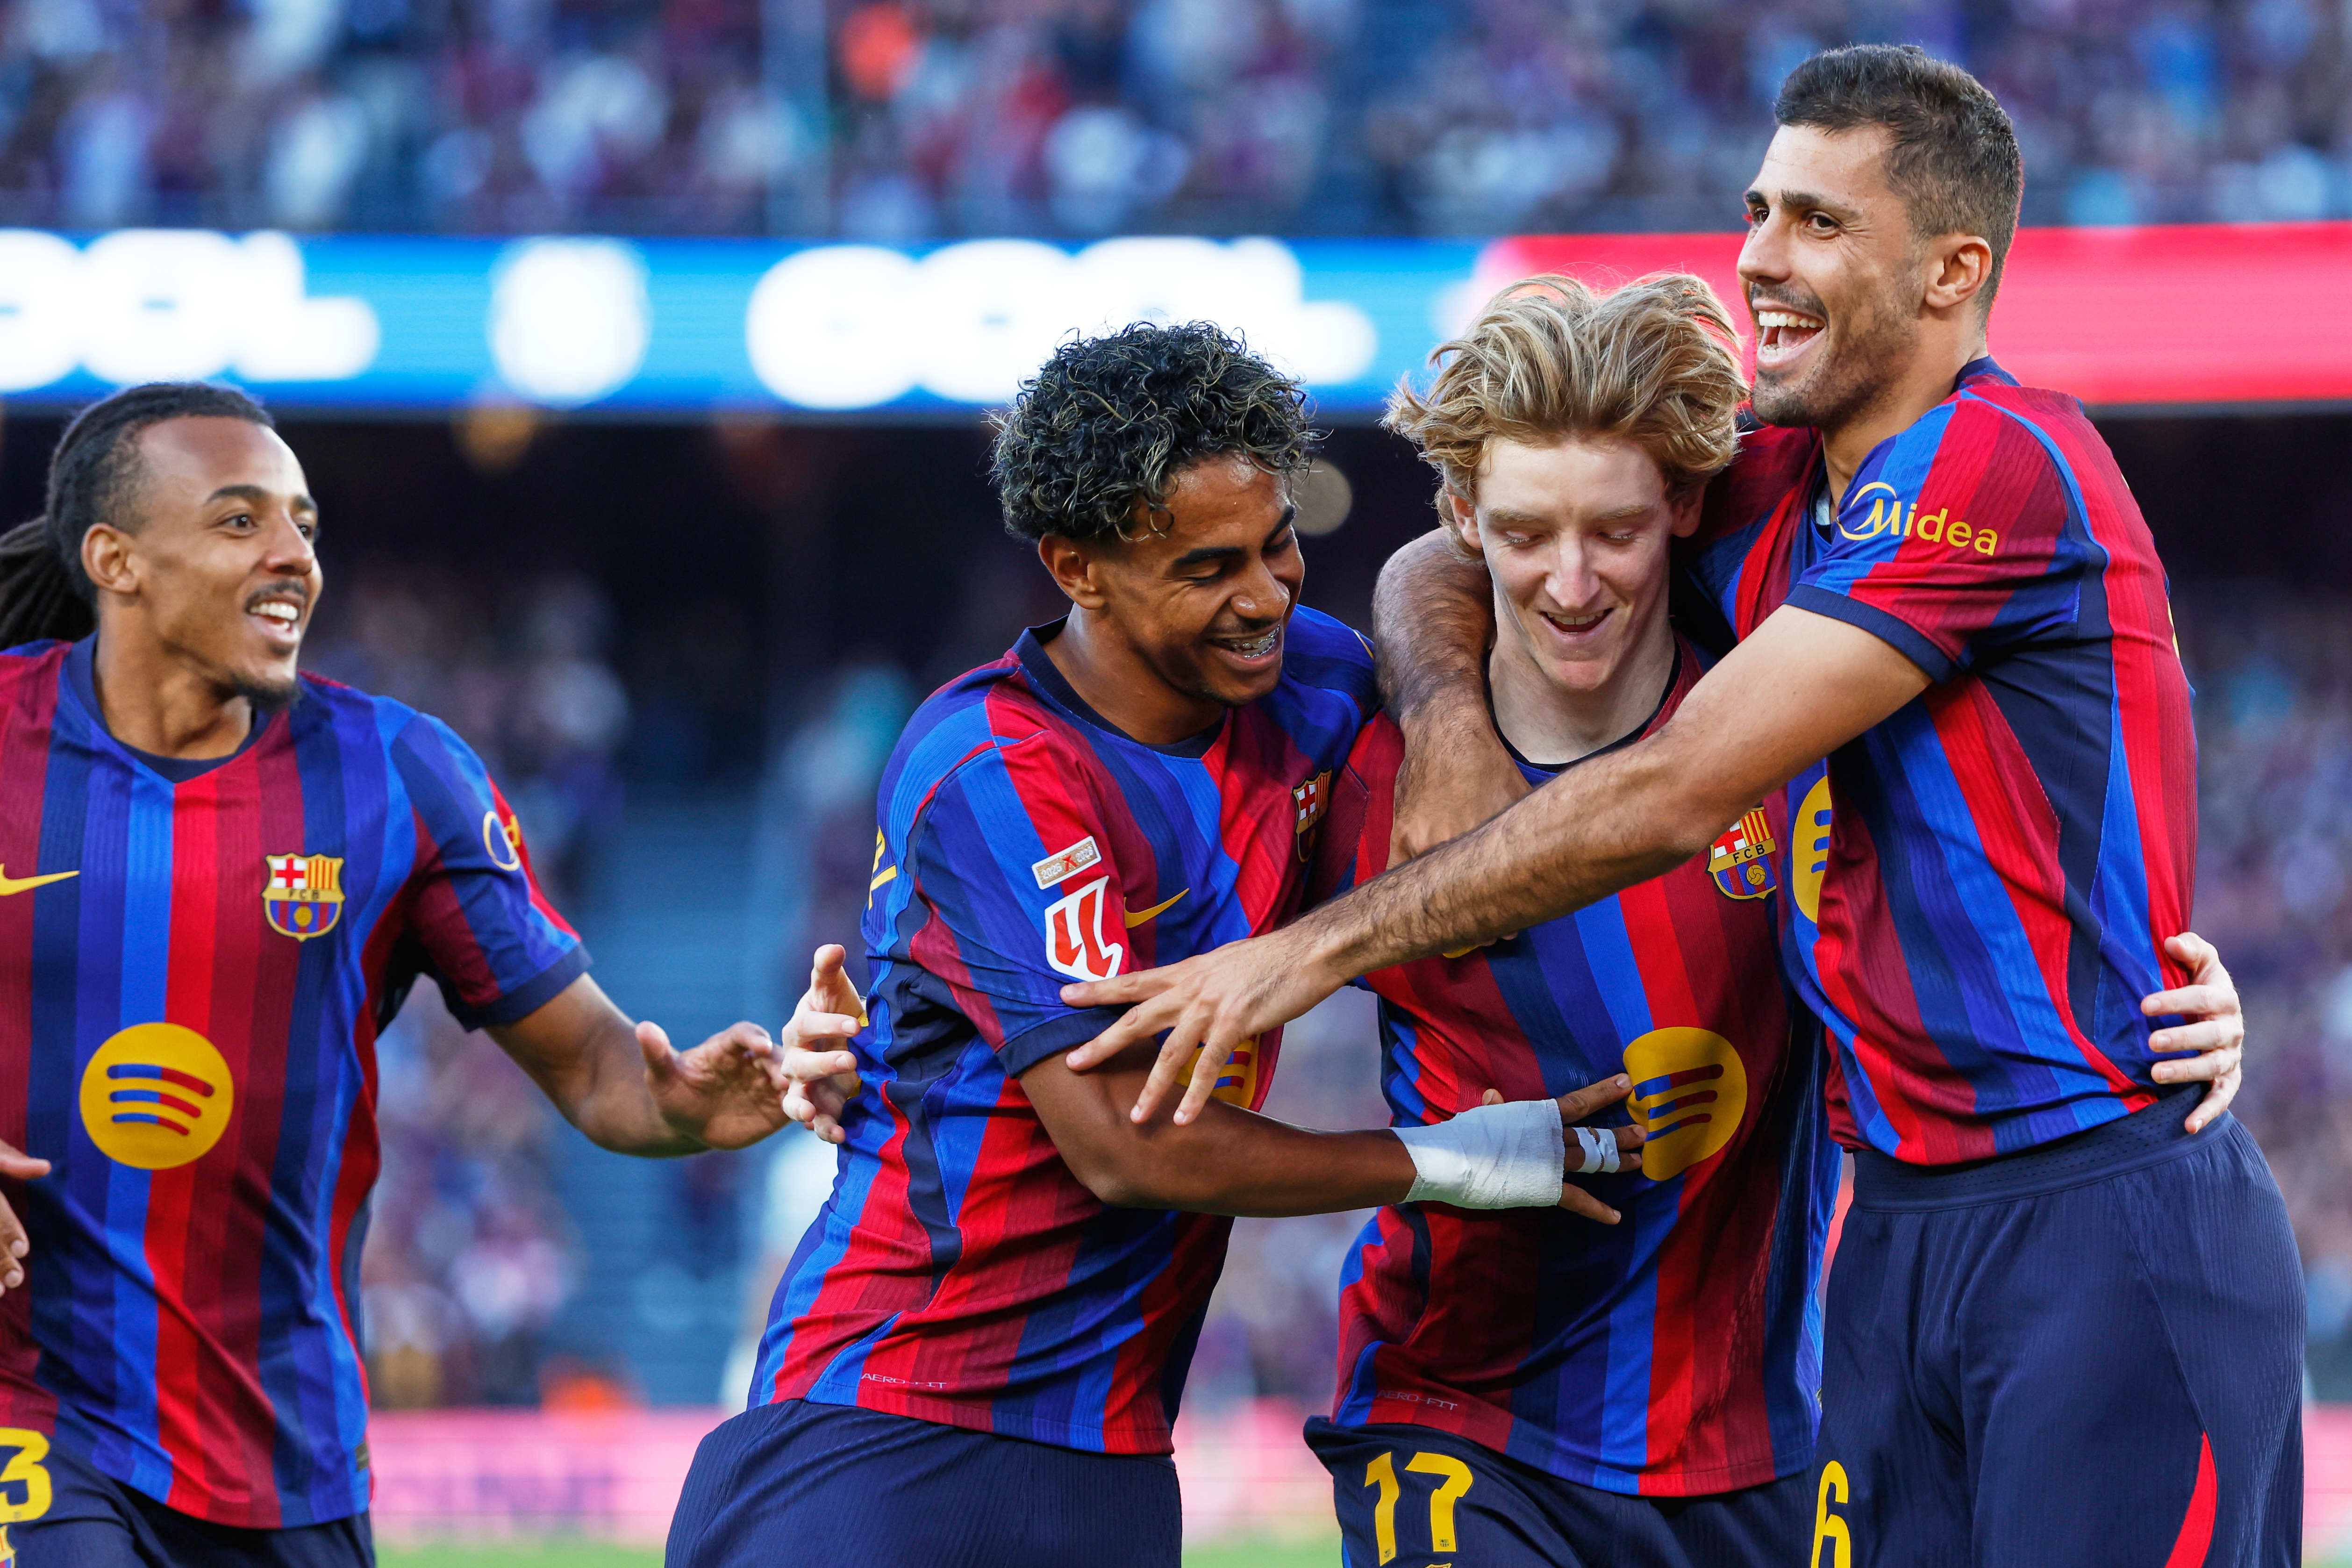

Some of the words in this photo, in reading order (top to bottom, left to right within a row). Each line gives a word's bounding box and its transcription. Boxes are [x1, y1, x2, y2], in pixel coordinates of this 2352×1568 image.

[1837, 491, 1999, 556] Midea
[1041, 862, 1063, 880] 2025
[1076, 846, 1094, 863] 2026
[1733, 844, 1765, 863] FCB
[1377, 1389, 1458, 1410] AERO-FIT
[0, 1427, 52, 1524] 3
[1364, 1452, 1474, 1567] 17
[1810, 1460, 1852, 1568] 6
